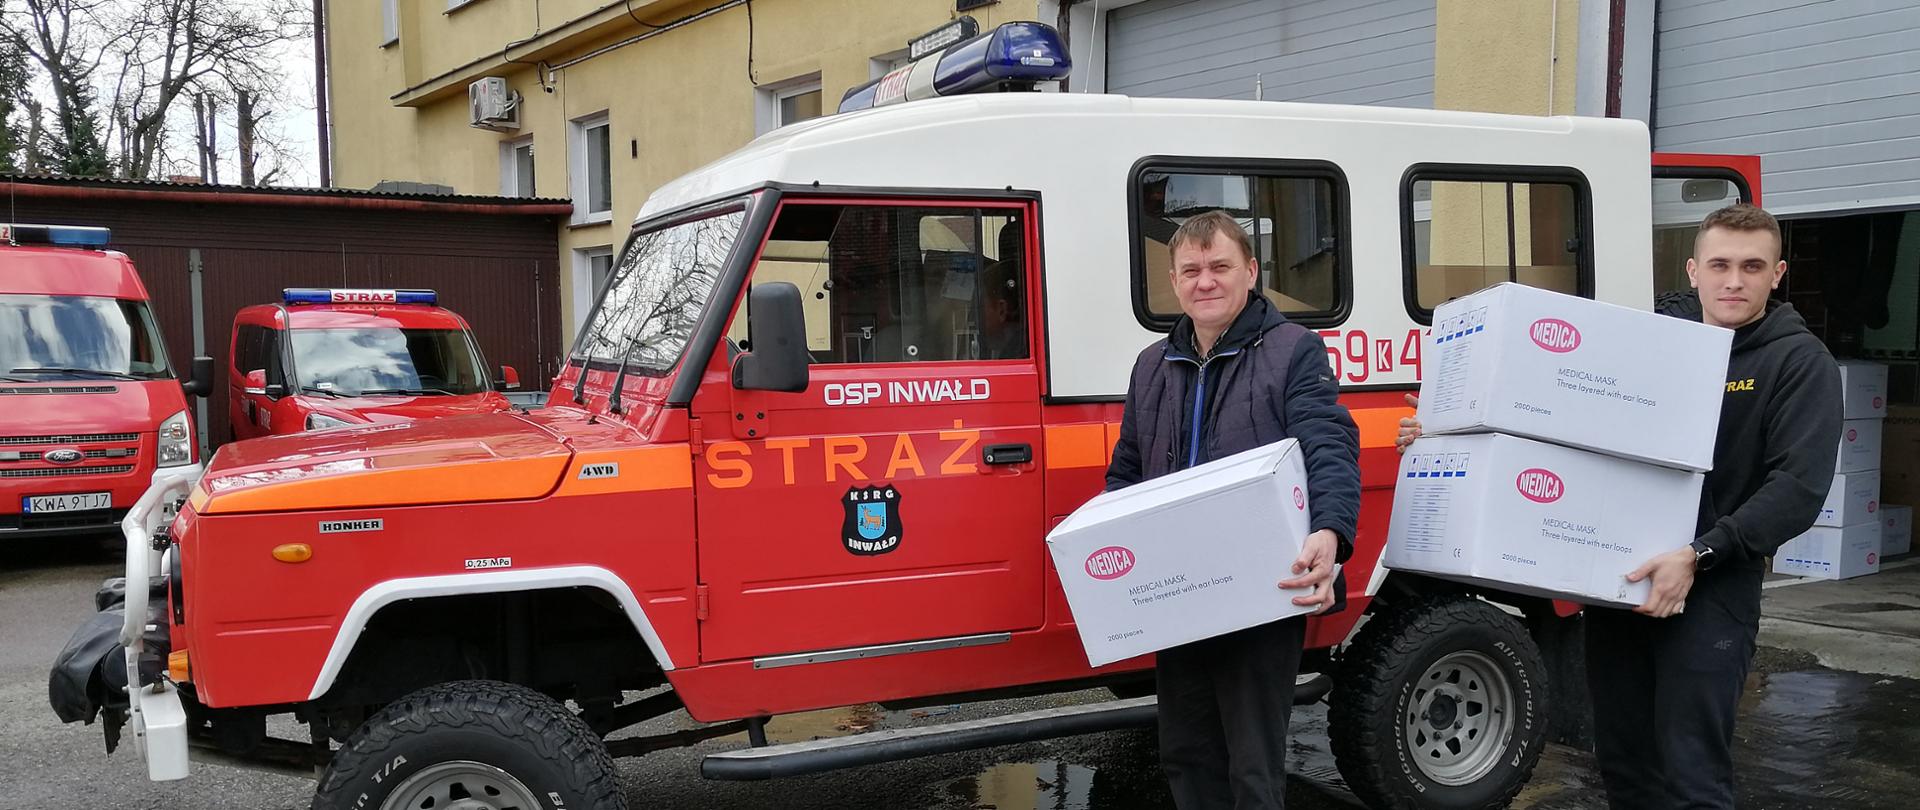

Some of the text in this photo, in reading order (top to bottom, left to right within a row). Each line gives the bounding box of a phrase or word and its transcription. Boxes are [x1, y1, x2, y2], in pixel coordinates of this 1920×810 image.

[1533, 322, 1576, 348] MEDICA
[1558, 368, 1617, 387] MEDICAL MASK
[824, 378, 990, 405] OSP INWAŁD
[1557, 379, 1656, 407] Three layered with ear loops
[1514, 402, 1551, 416] 2000 pieces
[54, 451, 75, 460] Ford
[706, 418, 980, 489] STRAŻ
[583, 466, 614, 476] 4WD
[1519, 473, 1560, 498] MEDICA
[33, 494, 108, 512] KWA 9TJ7
[323, 521, 379, 531] HONKER
[1543, 518, 1597, 535] MEDICAL MASK
[848, 536, 897, 551] INWAŁD
[1541, 529, 1632, 553] Three layered with ear loops
[490, 558, 510, 567] MPa
[1088, 550, 1132, 576] MEDICA
[1129, 574, 1187, 596] MEDICAL MASK
[1132, 575, 1233, 606] Three layered with ear loops
[1107, 633, 1123, 642] 2000
